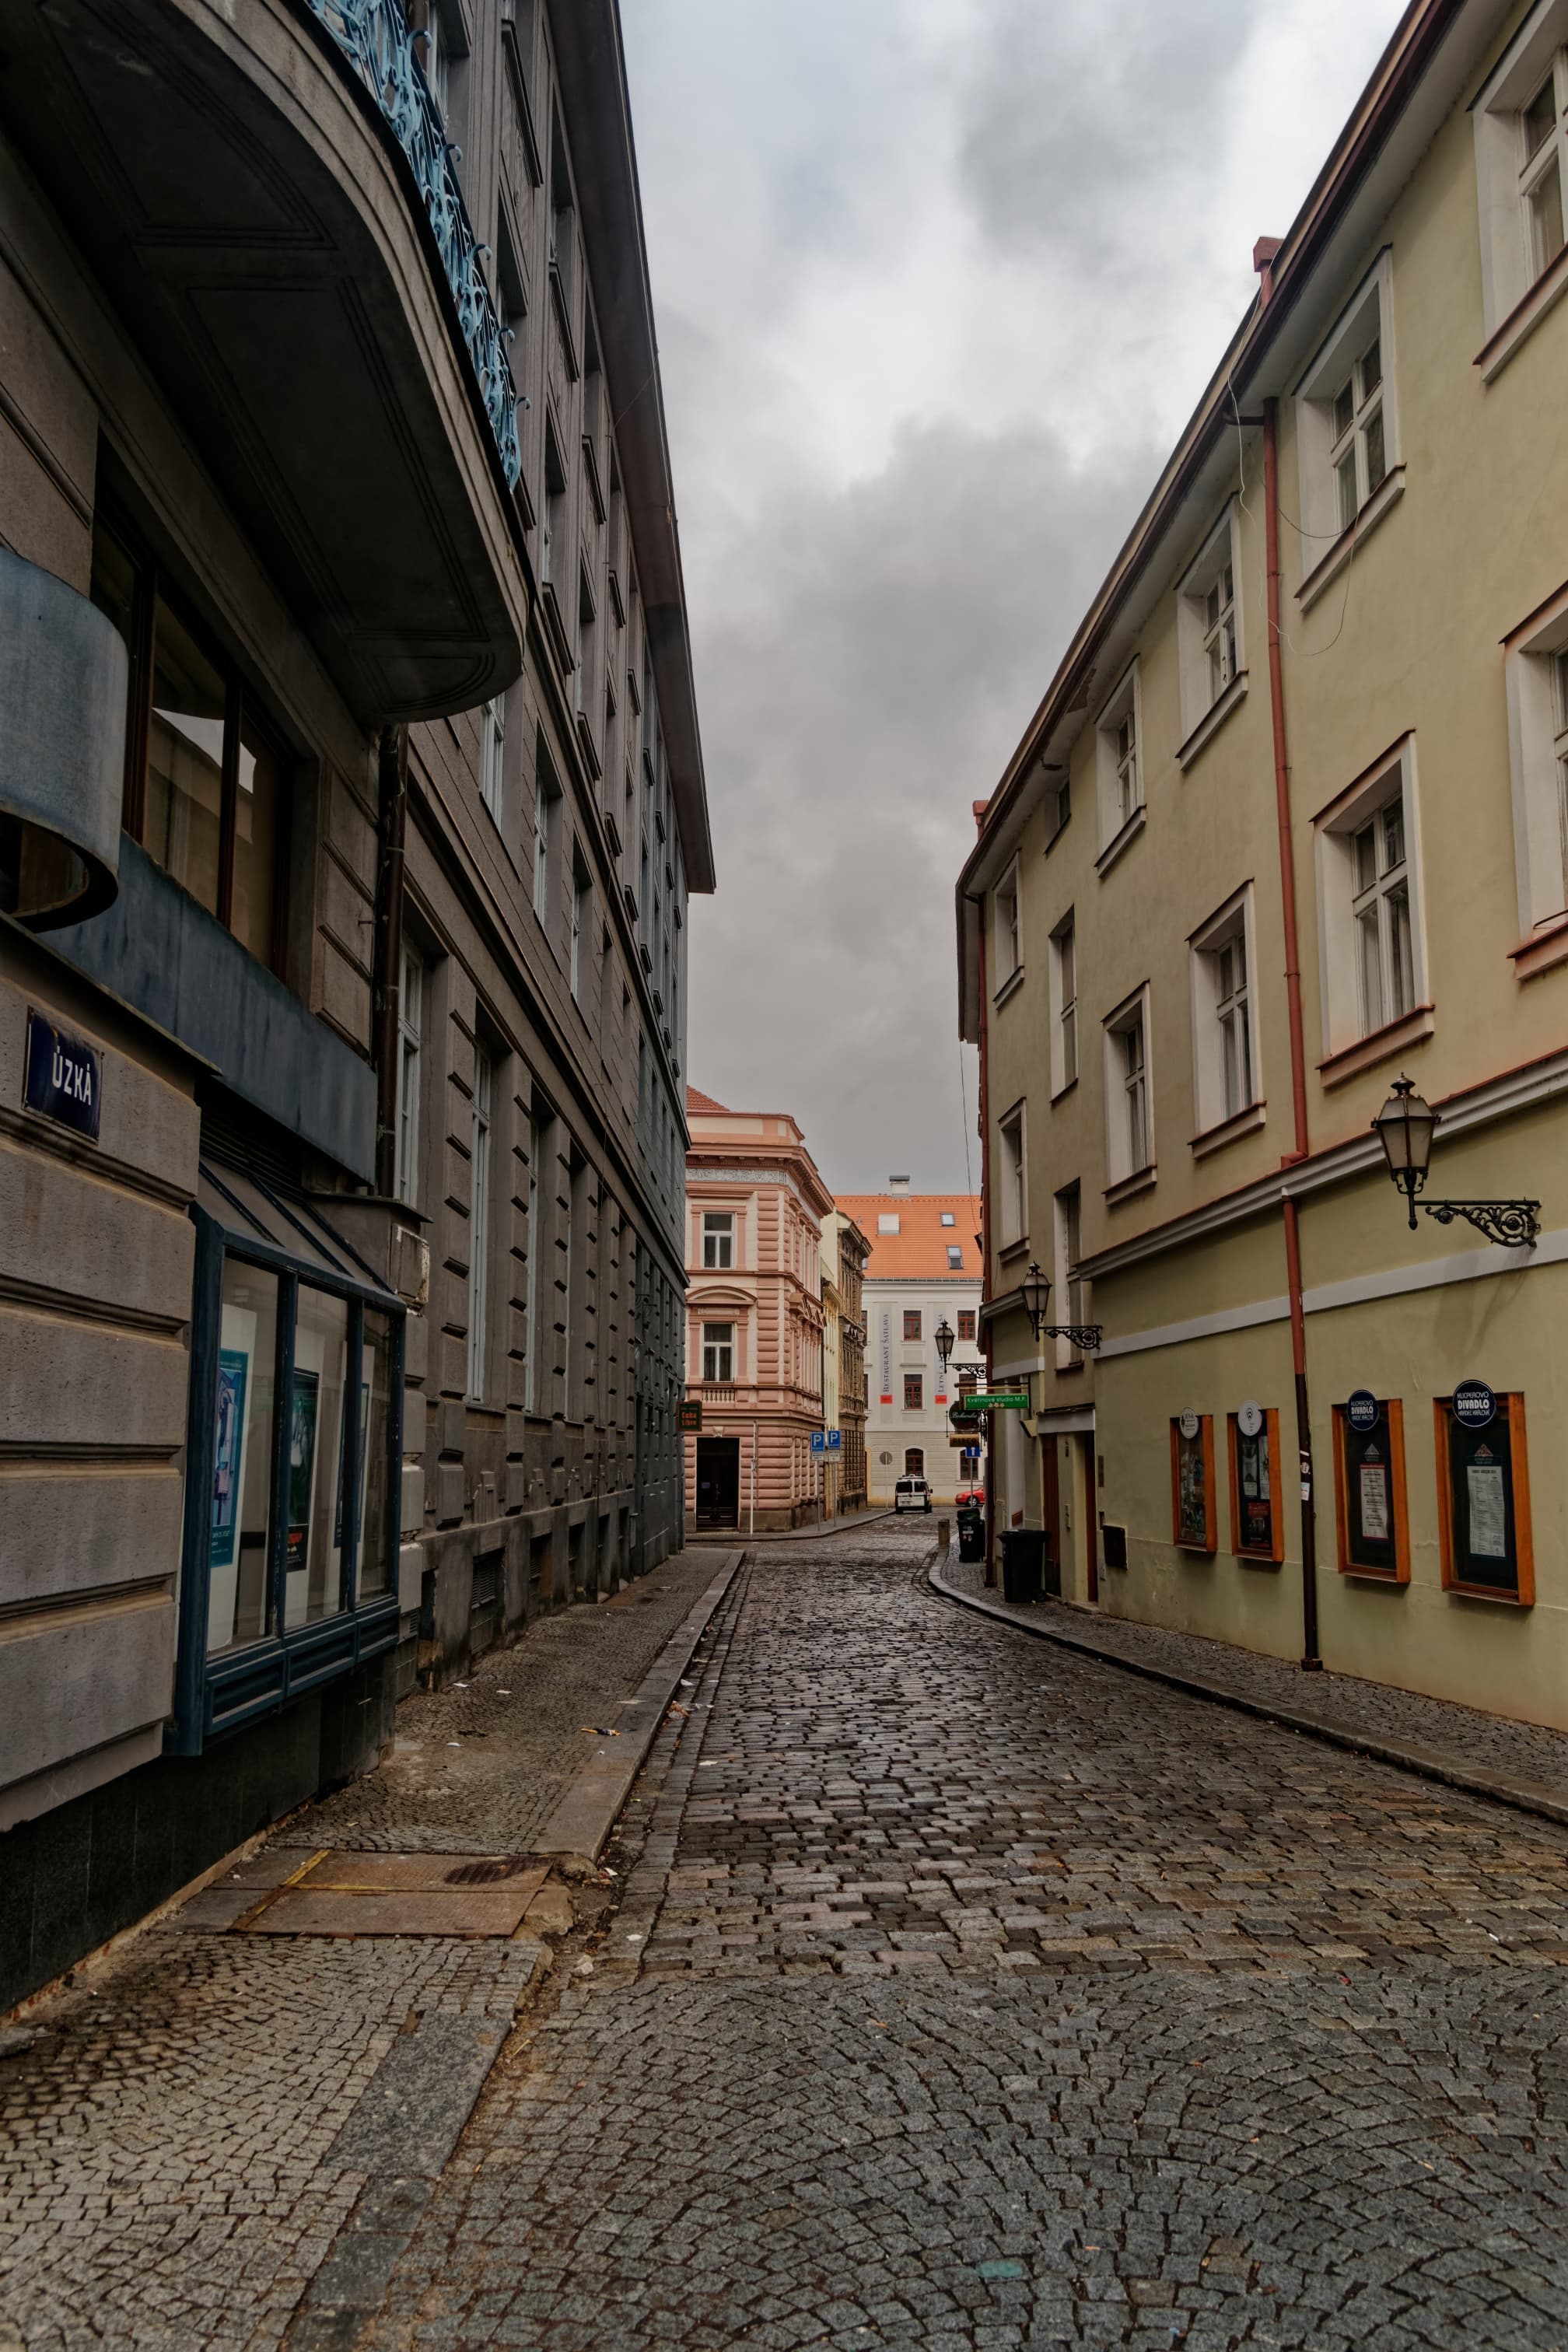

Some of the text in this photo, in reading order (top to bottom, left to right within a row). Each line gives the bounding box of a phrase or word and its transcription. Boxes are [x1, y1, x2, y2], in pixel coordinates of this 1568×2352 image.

[52, 1045, 92, 1105] ÚZKÁ
[1457, 1398, 1490, 1409] DIVADLO
[1350, 1406, 1374, 1415] DIVADLO
[813, 1434, 822, 1447] P
[830, 1432, 838, 1444] P
